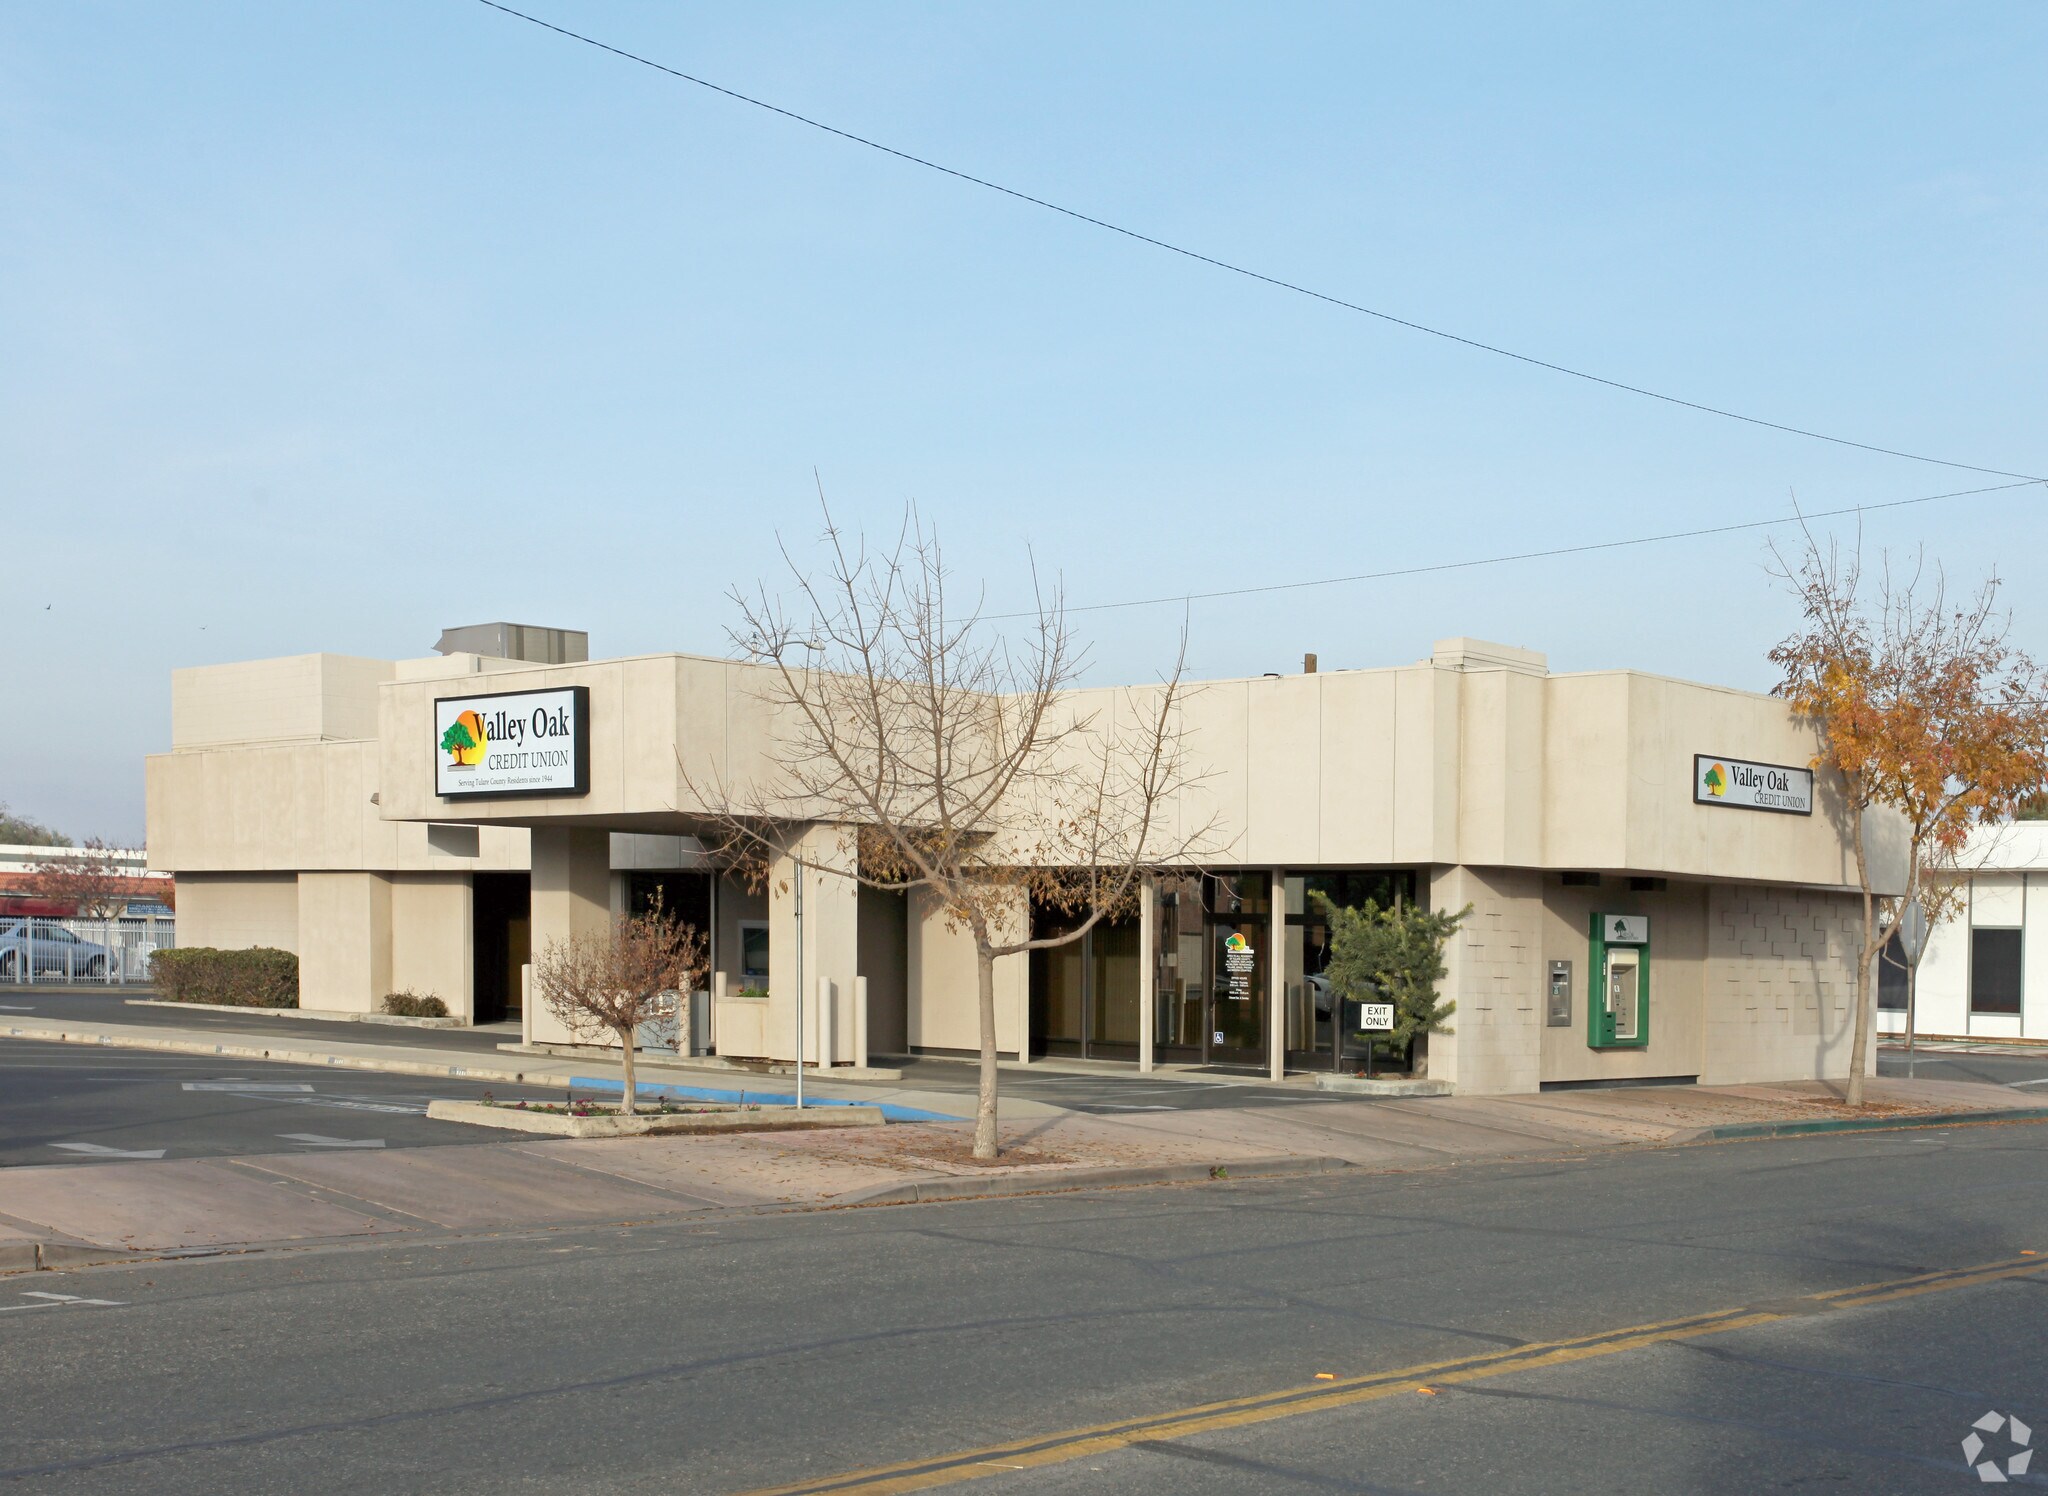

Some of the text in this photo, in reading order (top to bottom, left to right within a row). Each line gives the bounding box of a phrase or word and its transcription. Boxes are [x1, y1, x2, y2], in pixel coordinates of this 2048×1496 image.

[473, 706, 570, 747] Valley Oak
[488, 750, 568, 770] CREDIT UNION
[458, 779, 475, 788] Serving
[490, 777, 506, 786] County
[507, 776, 528, 785] Residents
[529, 776, 541, 784] since
[1731, 765, 1789, 793] Valley Oak
[1754, 792, 1805, 809] CREDIT UNION
[1367, 1006, 1387, 1015] EXIT
[1365, 1017, 1389, 1026] ONLY
